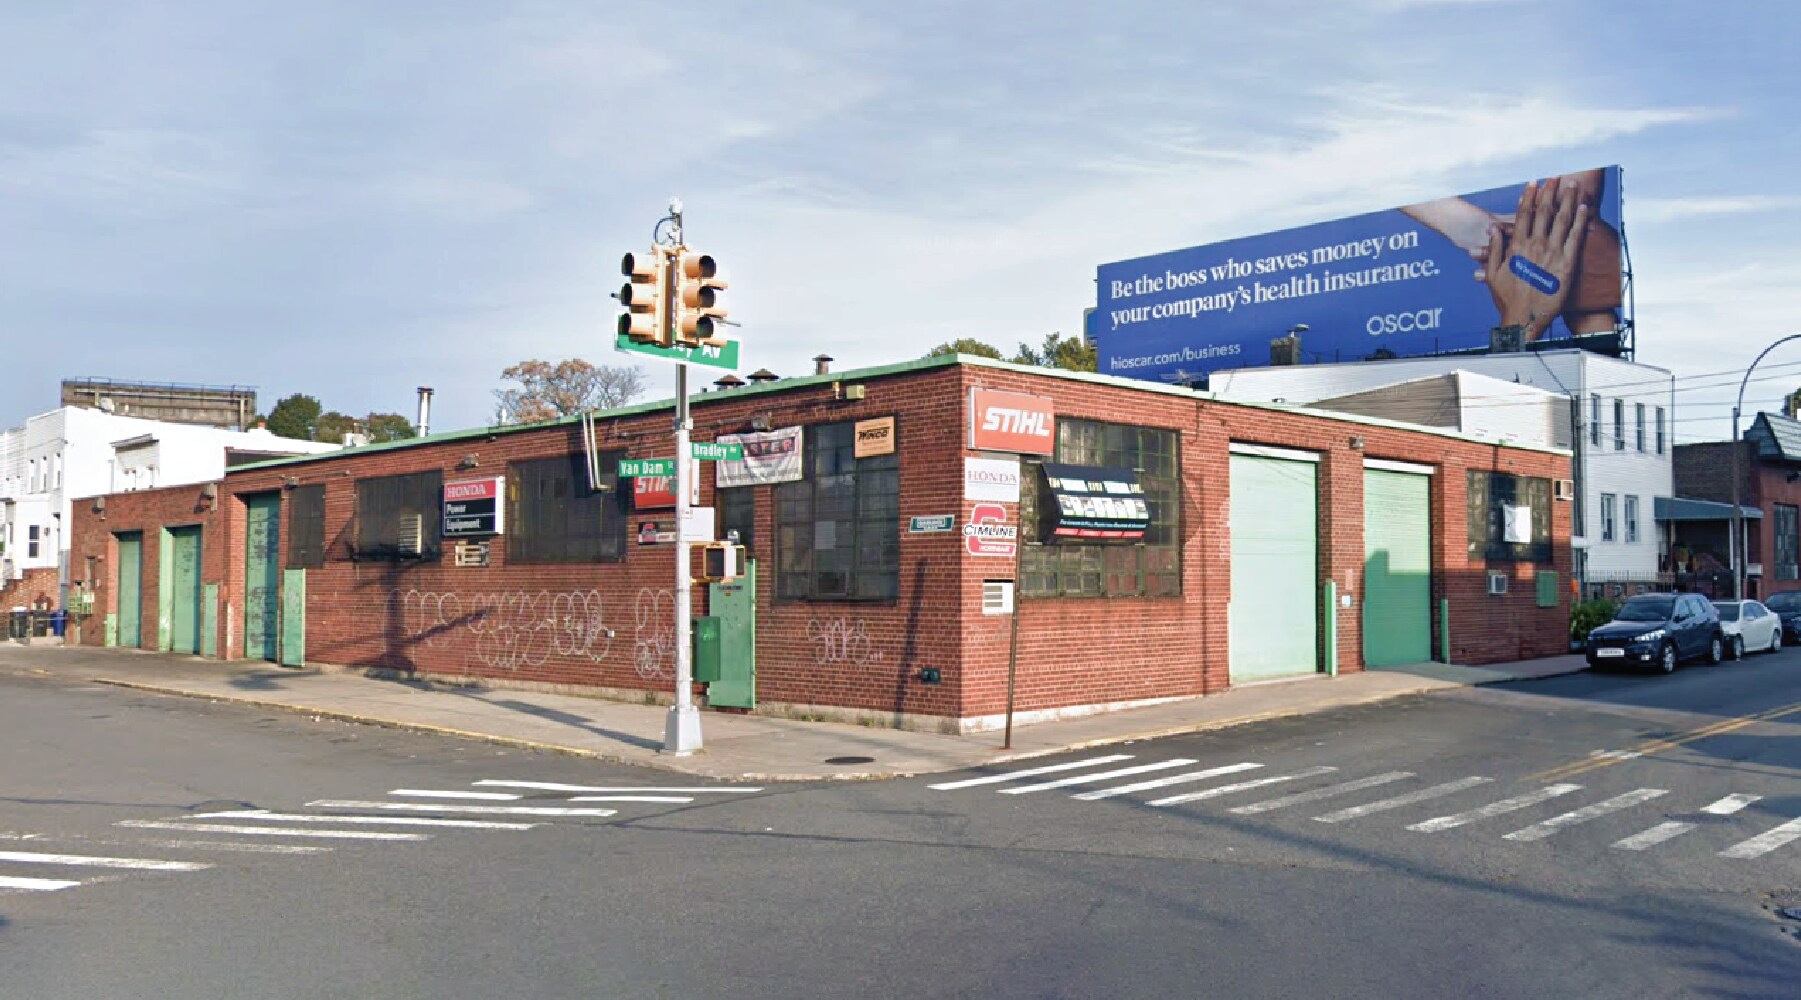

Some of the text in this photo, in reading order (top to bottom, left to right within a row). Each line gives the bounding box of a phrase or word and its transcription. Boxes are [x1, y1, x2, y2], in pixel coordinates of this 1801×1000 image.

[1111, 230, 1418, 299] Be the boss who saves money on
[1111, 306, 1151, 331] your
[1254, 273, 1321, 303] health
[1324, 259, 1440, 292] insurance.
[1366, 307, 1443, 335] oscar
[1110, 344, 1241, 370] hioscar.com/business
[982, 407, 1050, 437] STIHL
[693, 443, 727, 460] Bradley
[620, 462, 639, 475] Van
[642, 461, 664, 474] Dam
[967, 470, 1017, 484] HONDA
[447, 484, 486, 498] HONDA
[446, 503, 467, 515] Power
[963, 524, 1015, 537] CIMLINE
